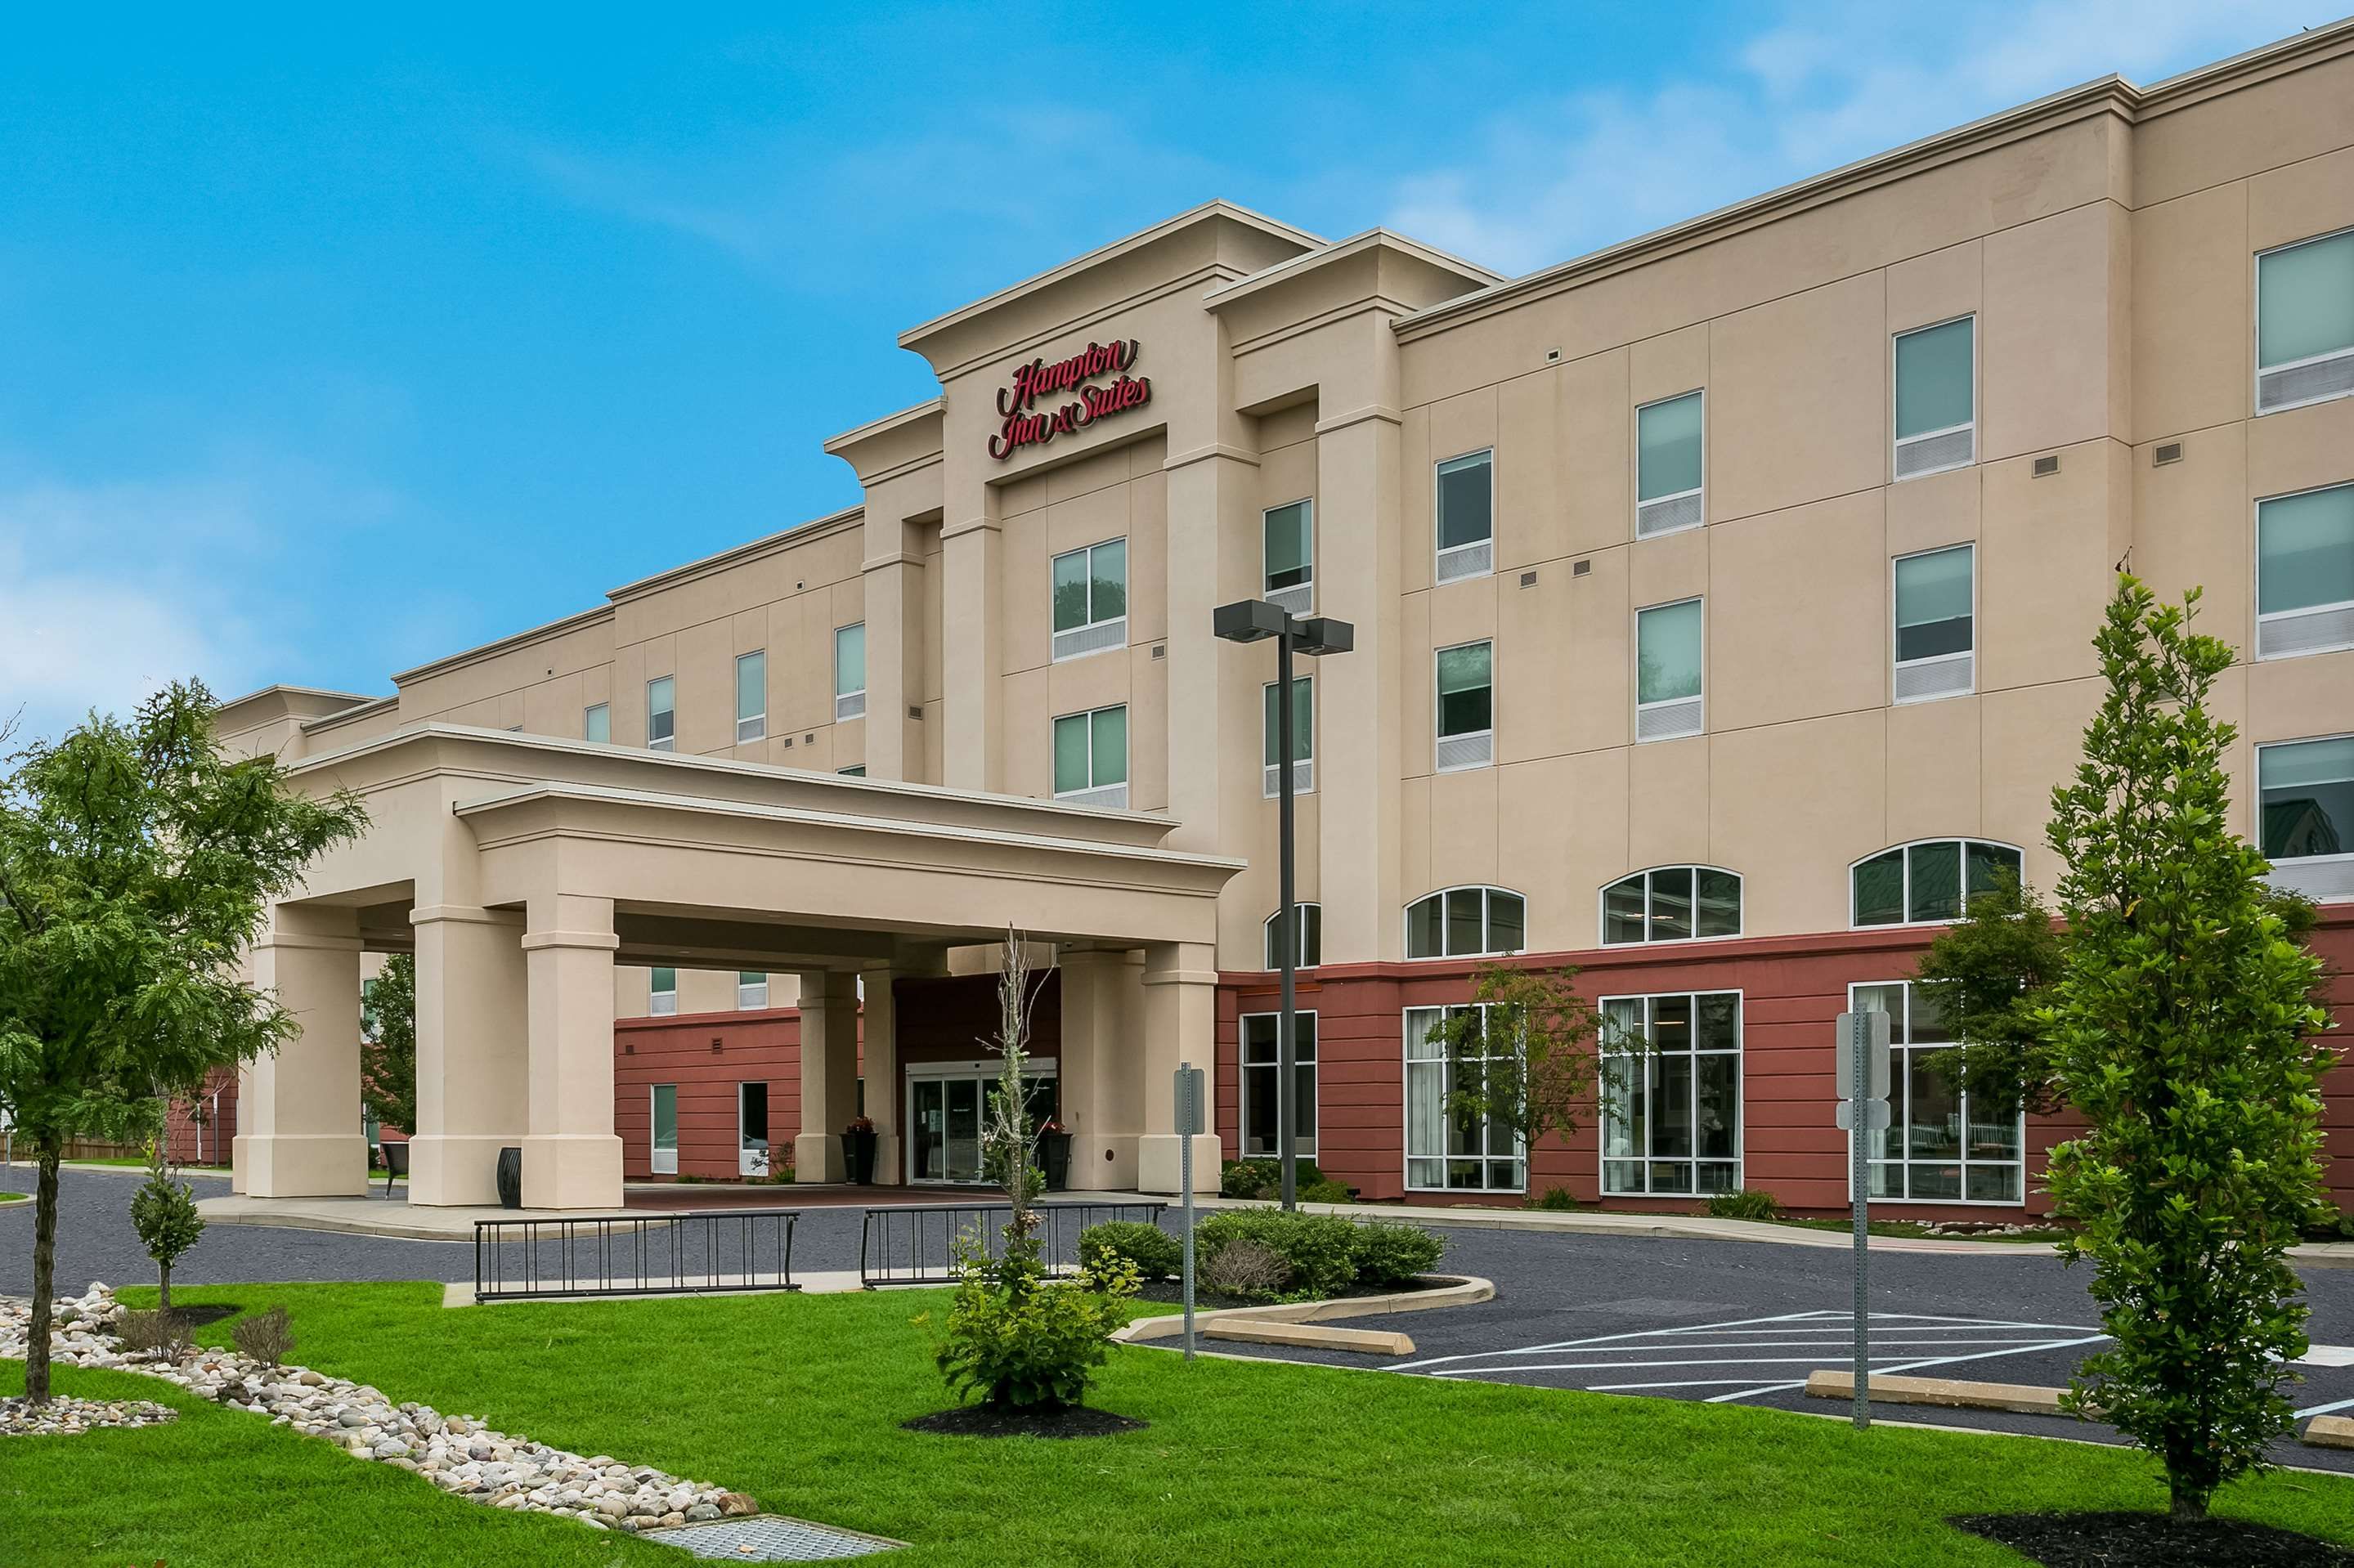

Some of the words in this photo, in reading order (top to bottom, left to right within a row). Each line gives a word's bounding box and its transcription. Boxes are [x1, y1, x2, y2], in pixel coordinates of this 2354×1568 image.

[988, 412, 1056, 459] Inn
[1054, 405, 1074, 433] &
[1069, 374, 1151, 428] Suites
[997, 338, 1139, 417] Hampton
